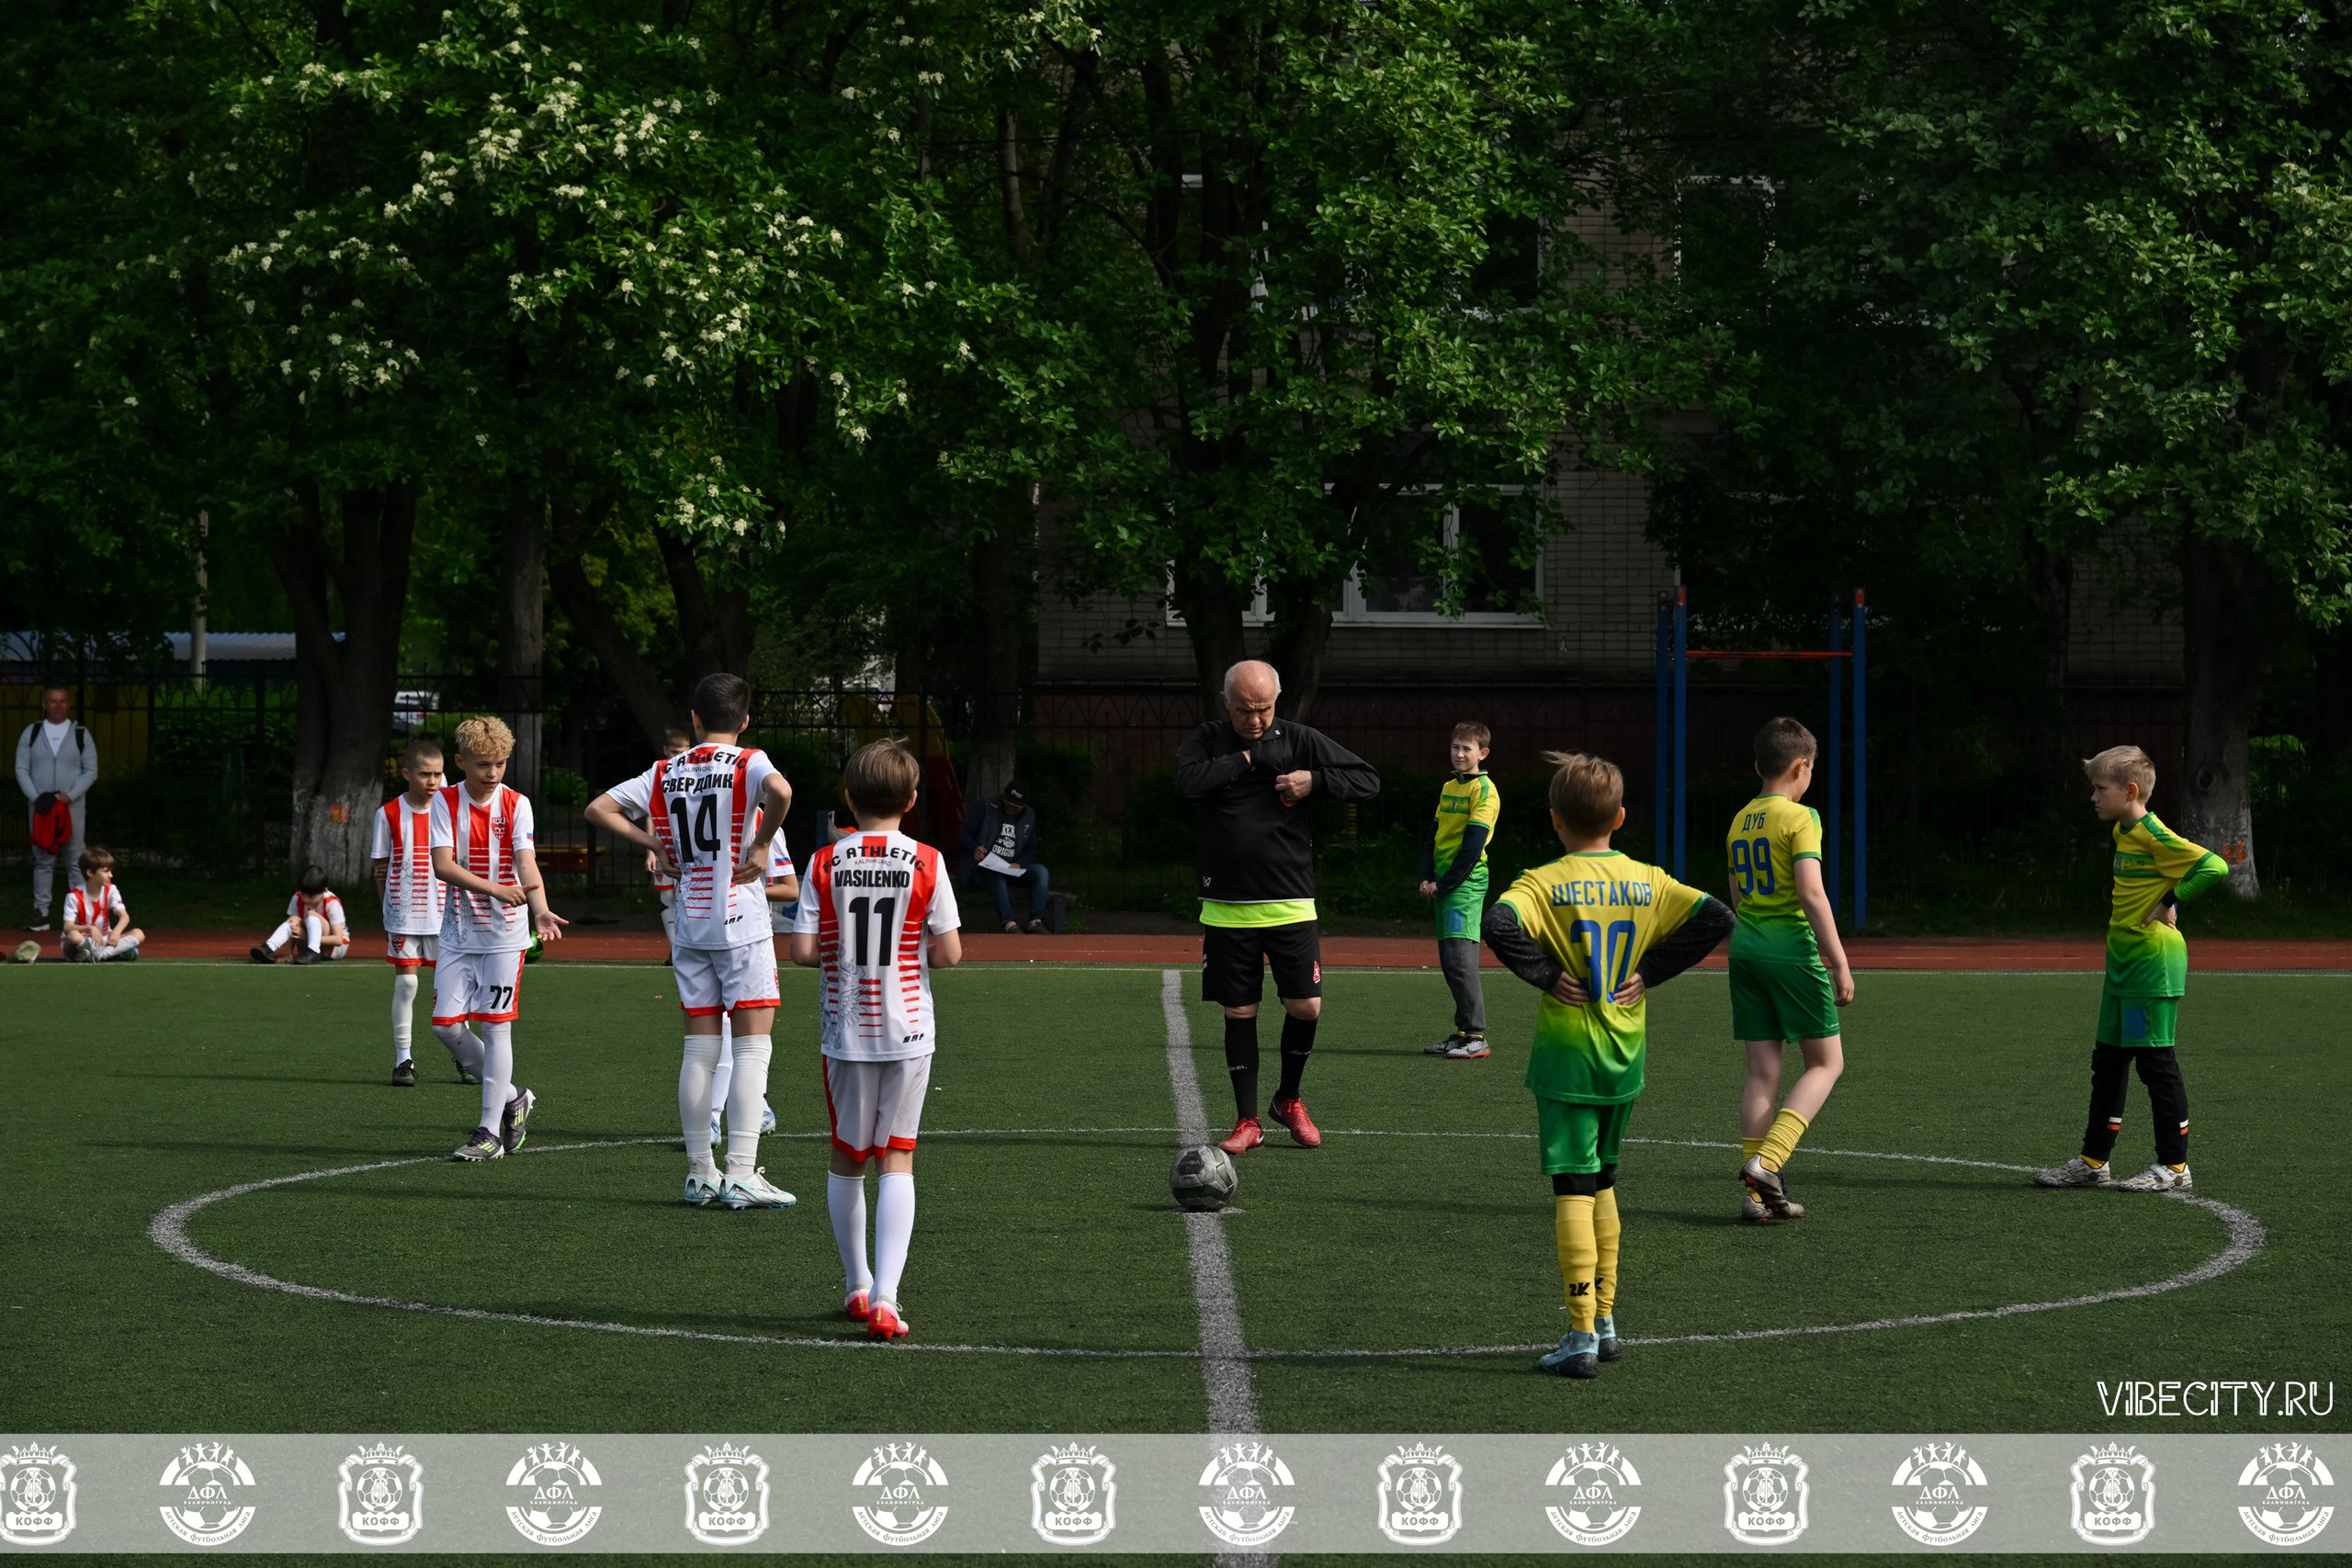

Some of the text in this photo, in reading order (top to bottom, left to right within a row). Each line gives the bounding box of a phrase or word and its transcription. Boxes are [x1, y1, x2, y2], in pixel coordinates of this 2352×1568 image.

[677, 751, 747, 770] ATHLETIC
[662, 773, 733, 795] СВЕРДЛИК
[670, 794, 720, 863] 14
[1742, 812, 1766, 833] ДУБ
[822, 845, 925, 874] FC ATHLETIC
[854, 858, 891, 867] KALININGRAD
[1731, 837, 1775, 896] 99
[834, 870, 910, 888] VASILENKO
[1552, 880, 1653, 908] ШЕСТАКОВ
[849, 897, 895, 966] 11
[1570, 919, 1635, 1003] 30
[491, 986, 513, 1009] 77
